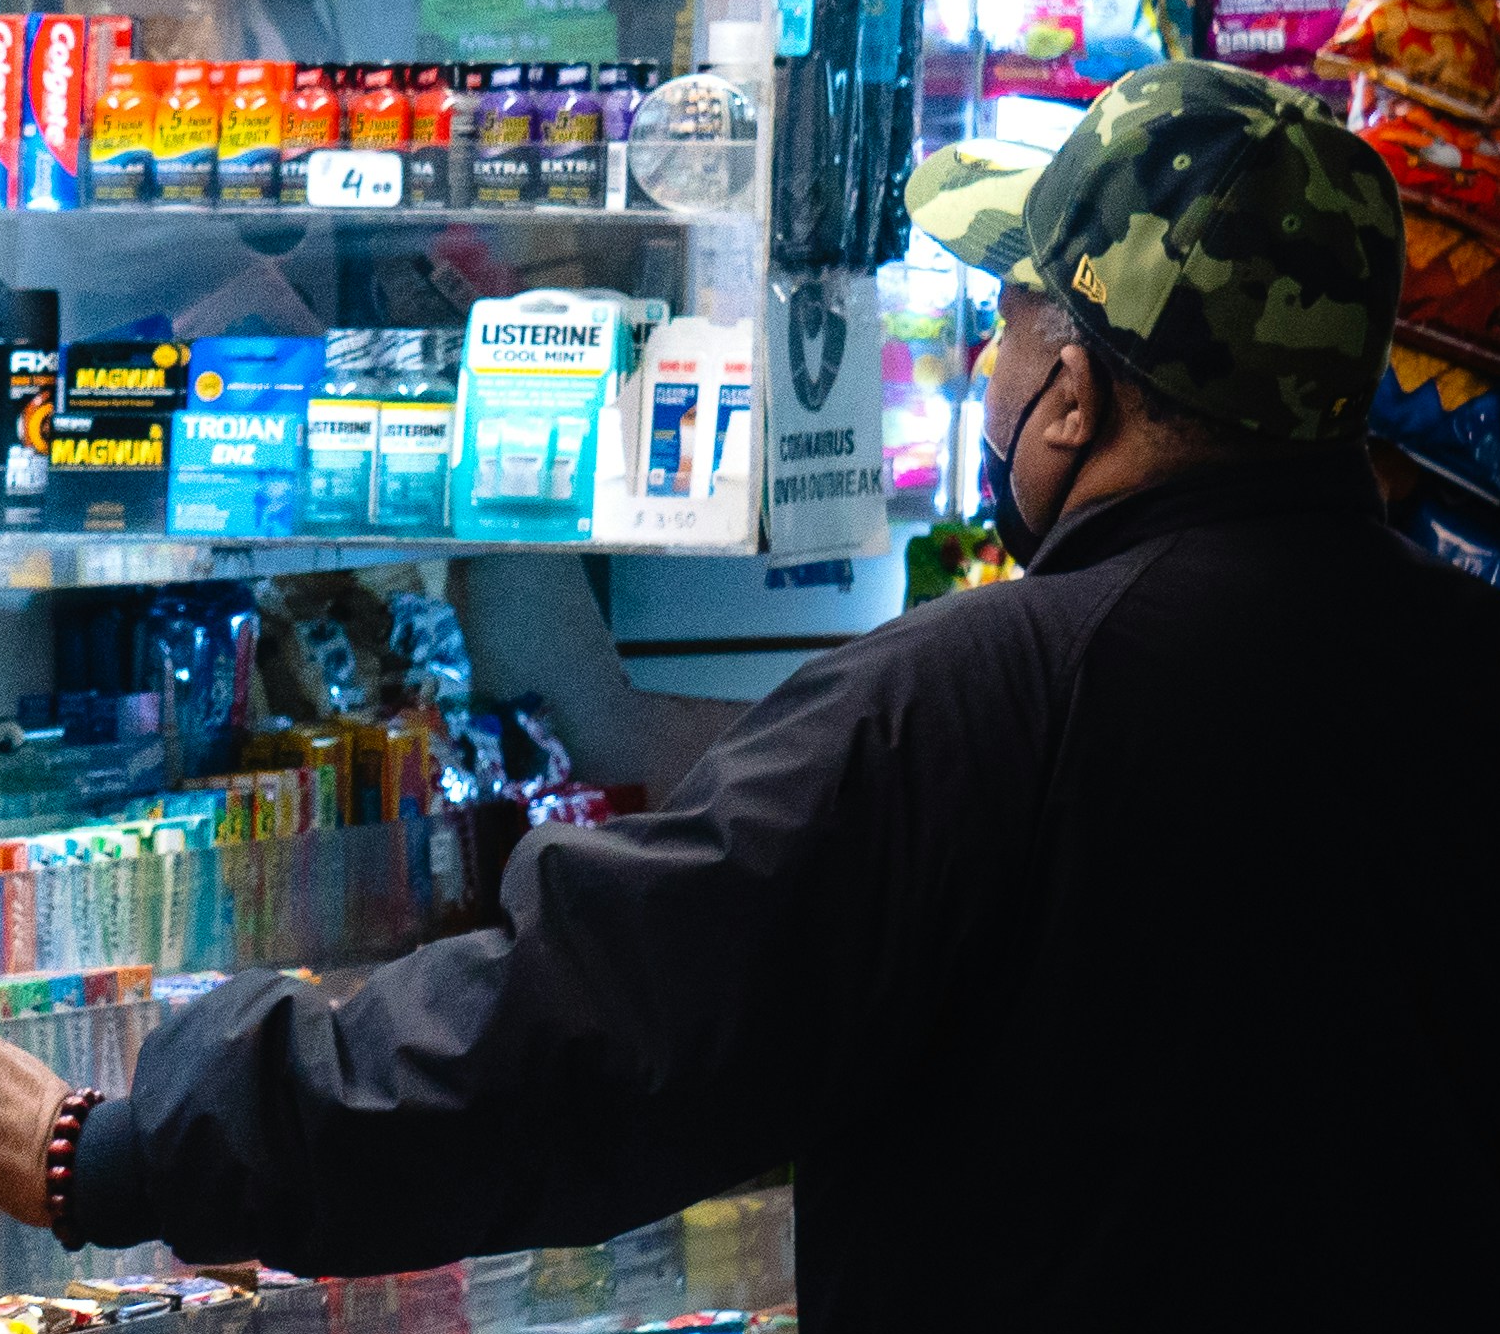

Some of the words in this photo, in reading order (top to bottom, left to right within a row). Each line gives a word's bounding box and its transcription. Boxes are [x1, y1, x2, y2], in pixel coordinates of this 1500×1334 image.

[42, 23, 76, 146] Colgate
[473, 160, 530, 175] EXTRA
[541, 159, 597, 174] EXTRA
[481, 323, 604, 348] LISTERINE
[493, 349, 538, 364] COOL
[544, 348, 587, 364] MINT
[76, 368, 166, 390] MAGNUM
[181, 417, 286, 442] TROJAN
[51, 438, 163, 467] MAGNUM
